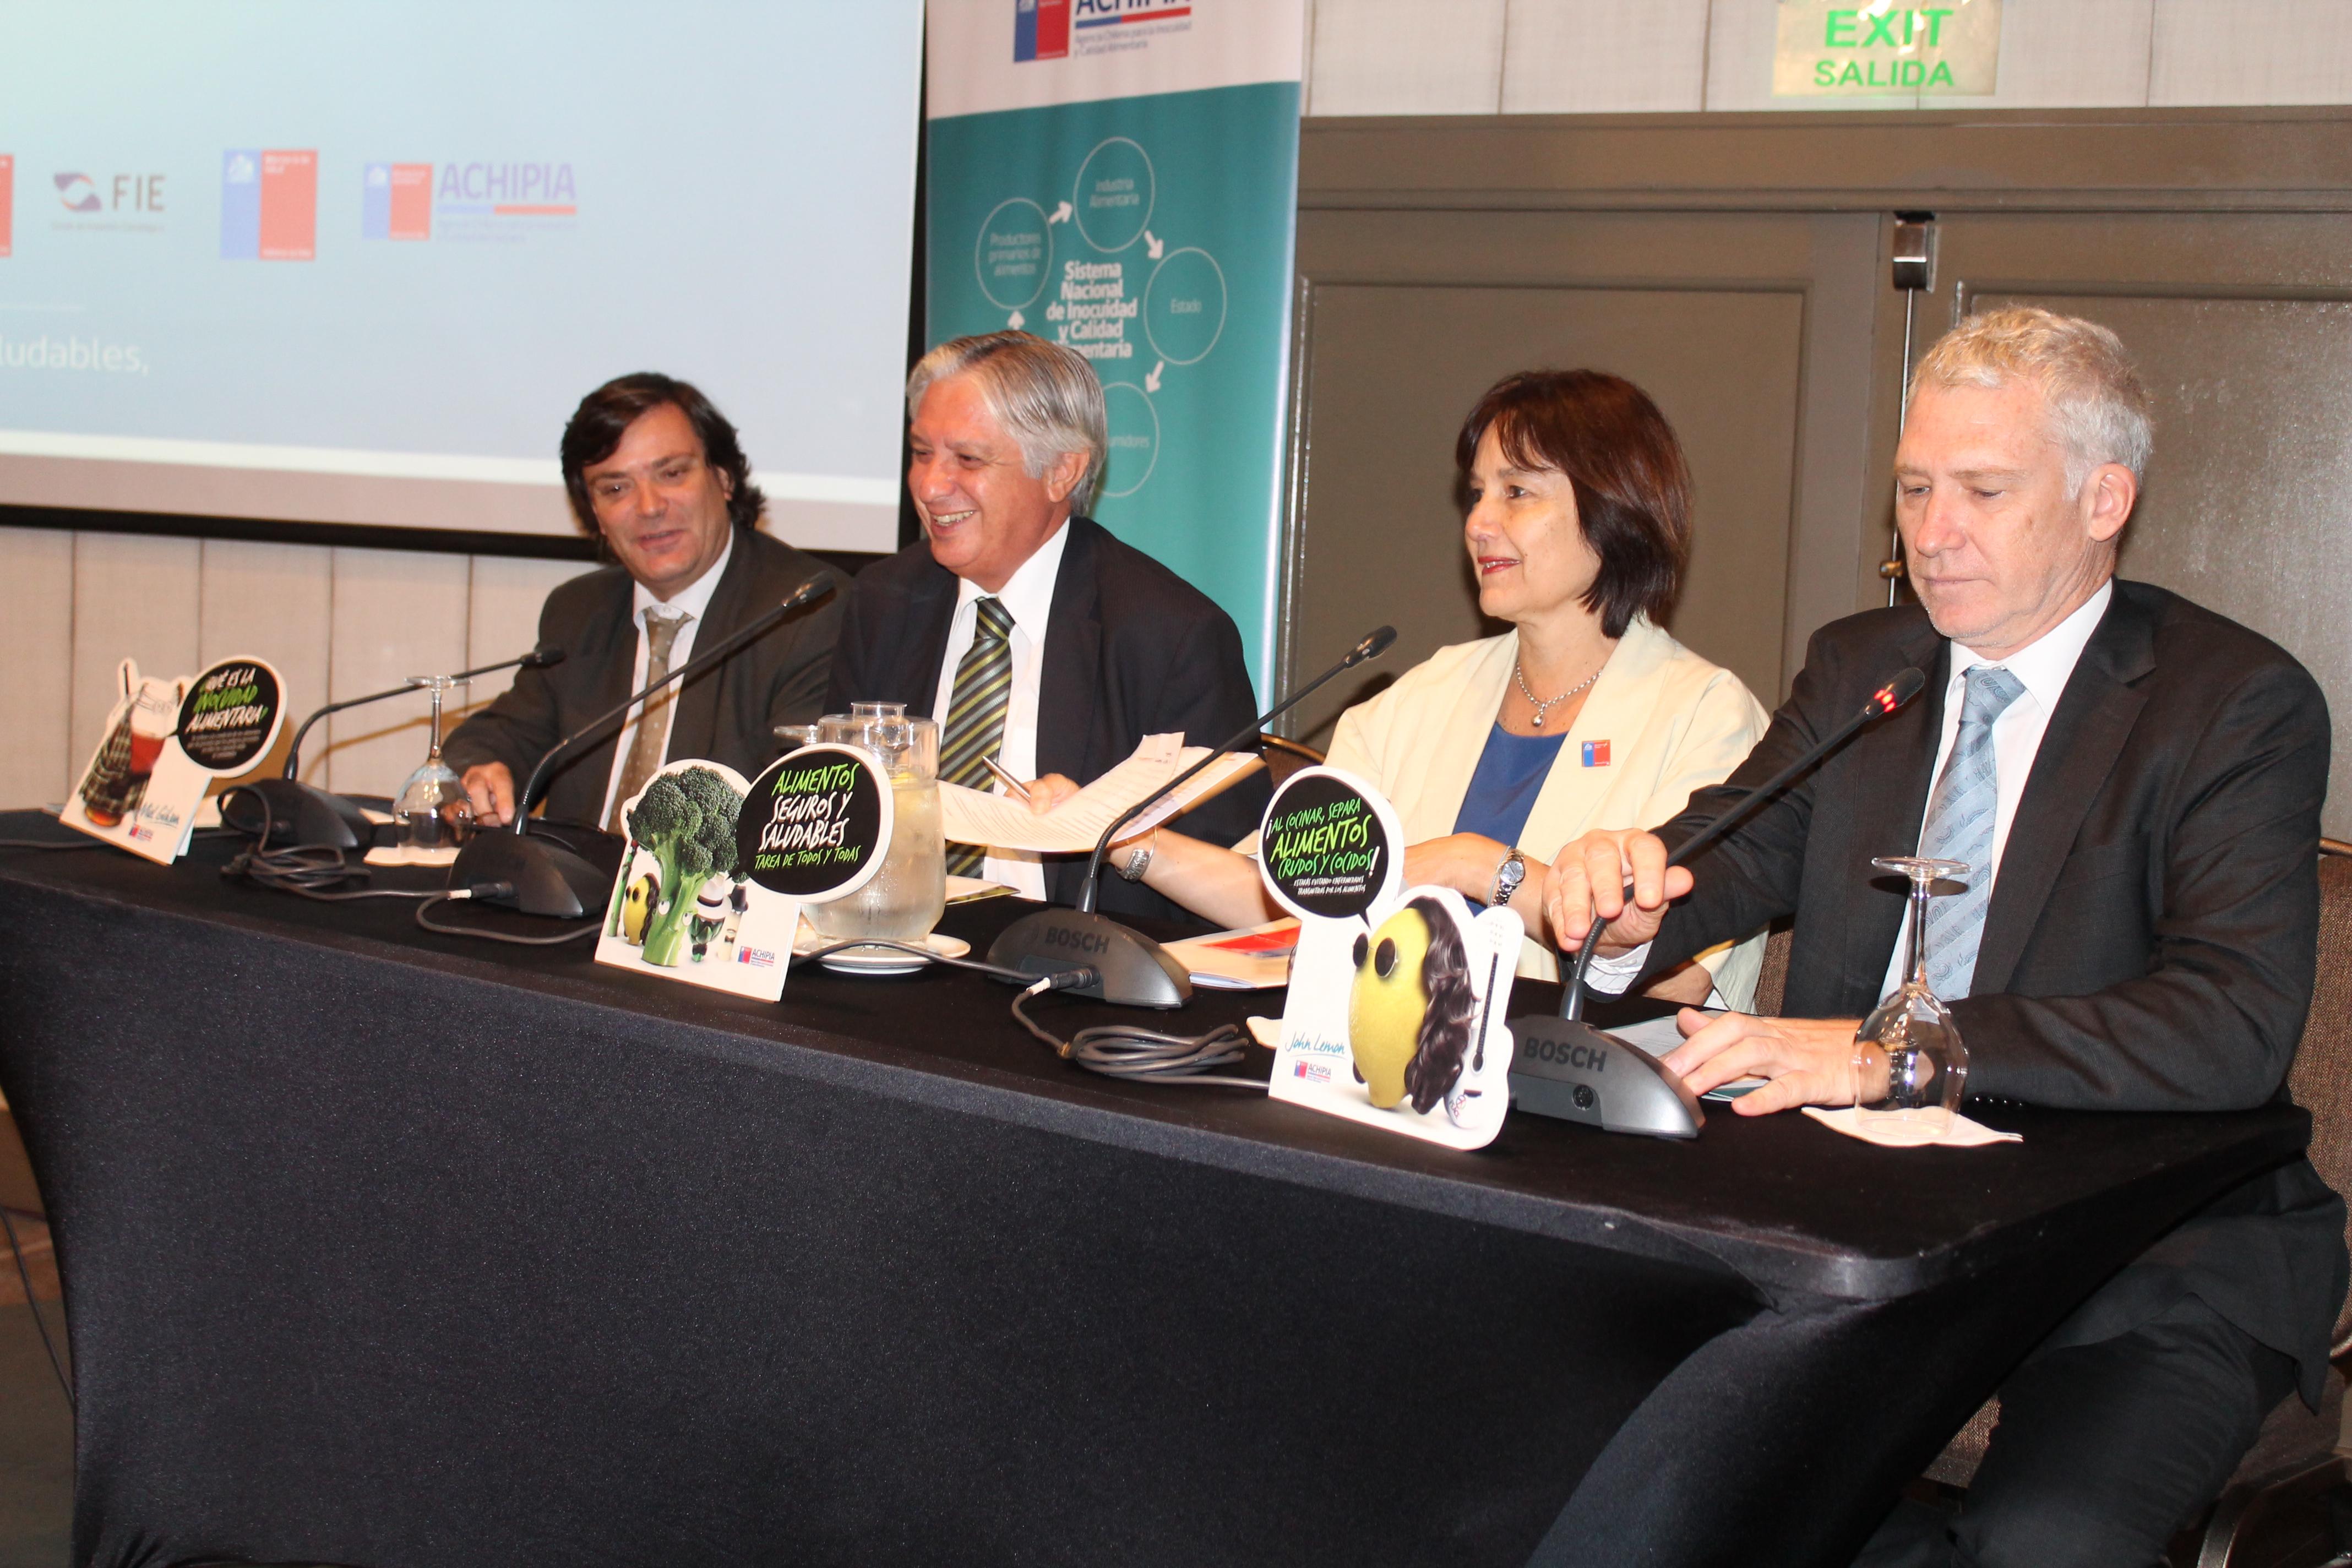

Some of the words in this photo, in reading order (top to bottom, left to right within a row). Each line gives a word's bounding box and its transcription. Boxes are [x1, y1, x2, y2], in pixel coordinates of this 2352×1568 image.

[1825, 9, 1954, 48] EXIT
[1813, 60, 1955, 87] SALIDA
[113, 175, 166, 212] FIE
[439, 163, 576, 200] ACHIPIA
[1064, 260, 1122, 280] Sistema
[1060, 277, 1124, 300] Nacional
[1046, 301, 1065, 321] de
[1067, 297, 1139, 320] Inocuidad
[1058, 325, 1069, 344] y
[1069, 318, 1124, 340] Calidad
[771, 763, 860, 797] ALIMENTOS
[771, 791, 837, 824] SEGUROS
[836, 791, 853, 821] Y
[1286, 807, 1325, 831] COCINAR,
[1327, 797, 1361, 821] SEPARA
[758, 817, 850, 853] SALUDABLES
[1270, 814, 1373, 864] ALIMENTOS
[754, 853, 781, 870] TAREA
[782, 853, 796, 867] DE
[797, 848, 824, 868] TODOS
[823, 848, 833, 865] Y
[833, 845, 862, 863] TODAS
[1278, 854, 1320, 880] CRUDOS
[1319, 854, 1331, 875] Y
[1325, 886, 1334, 895] POR
[1334, 885, 1343, 894] LOS
[1342, 884, 1366, 893] ALIMENTOS
[1046, 925, 1110, 954] BOSCH
[752, 948, 775, 961] ACHIPIA
[1284, 1031, 1311, 1052] John
[1313, 1032, 1346, 1055] Lemon
[1522, 1037, 1607, 1072] BOSCH
[1308, 1063, 1331, 1076] ACHIPIA
